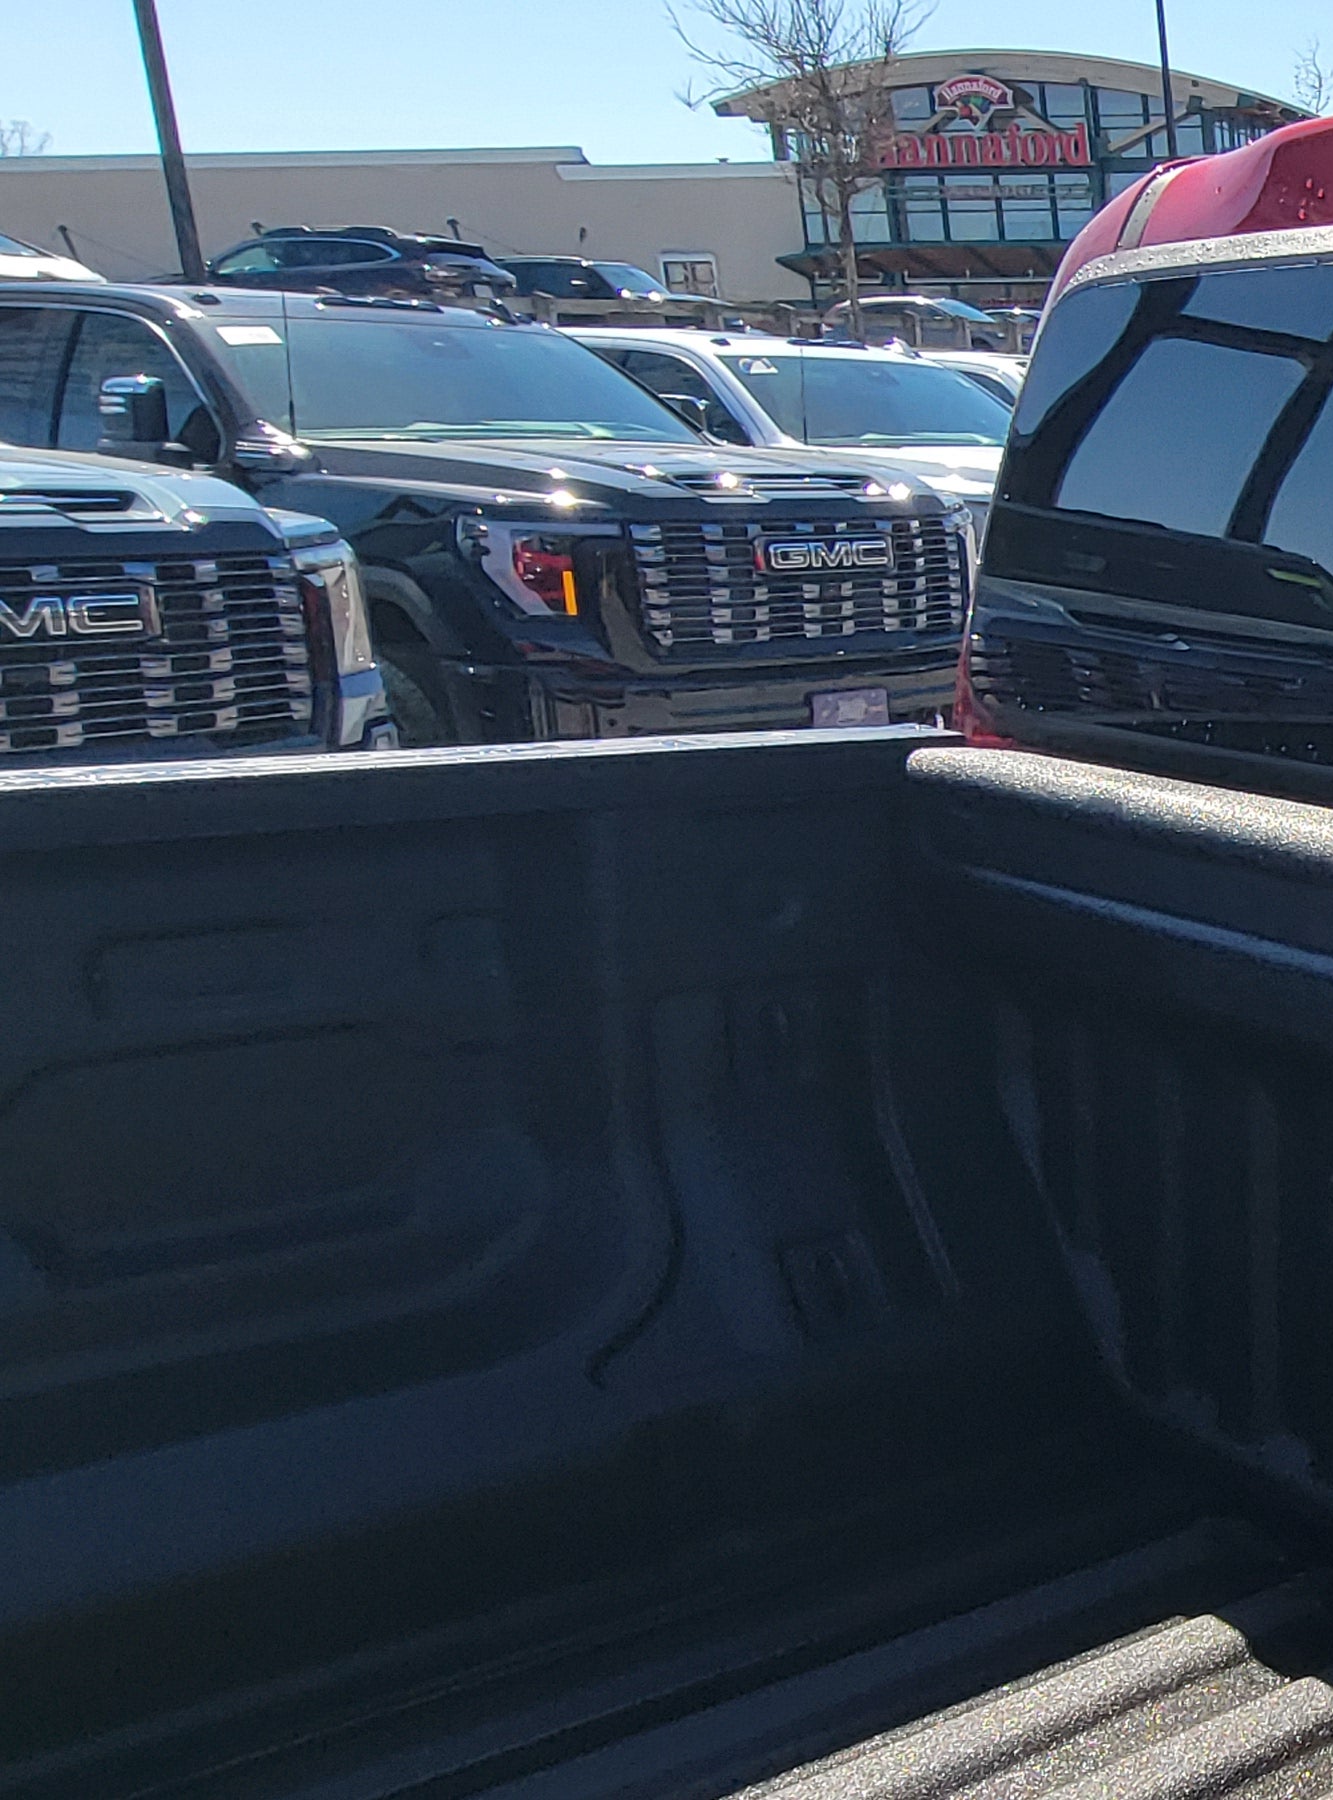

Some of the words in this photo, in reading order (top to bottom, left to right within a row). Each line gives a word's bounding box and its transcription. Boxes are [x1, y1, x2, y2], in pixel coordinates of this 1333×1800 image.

[941, 79, 1003, 102] Hannaford
[769, 540, 888, 569] GMC
[0, 594, 144, 637] MC
